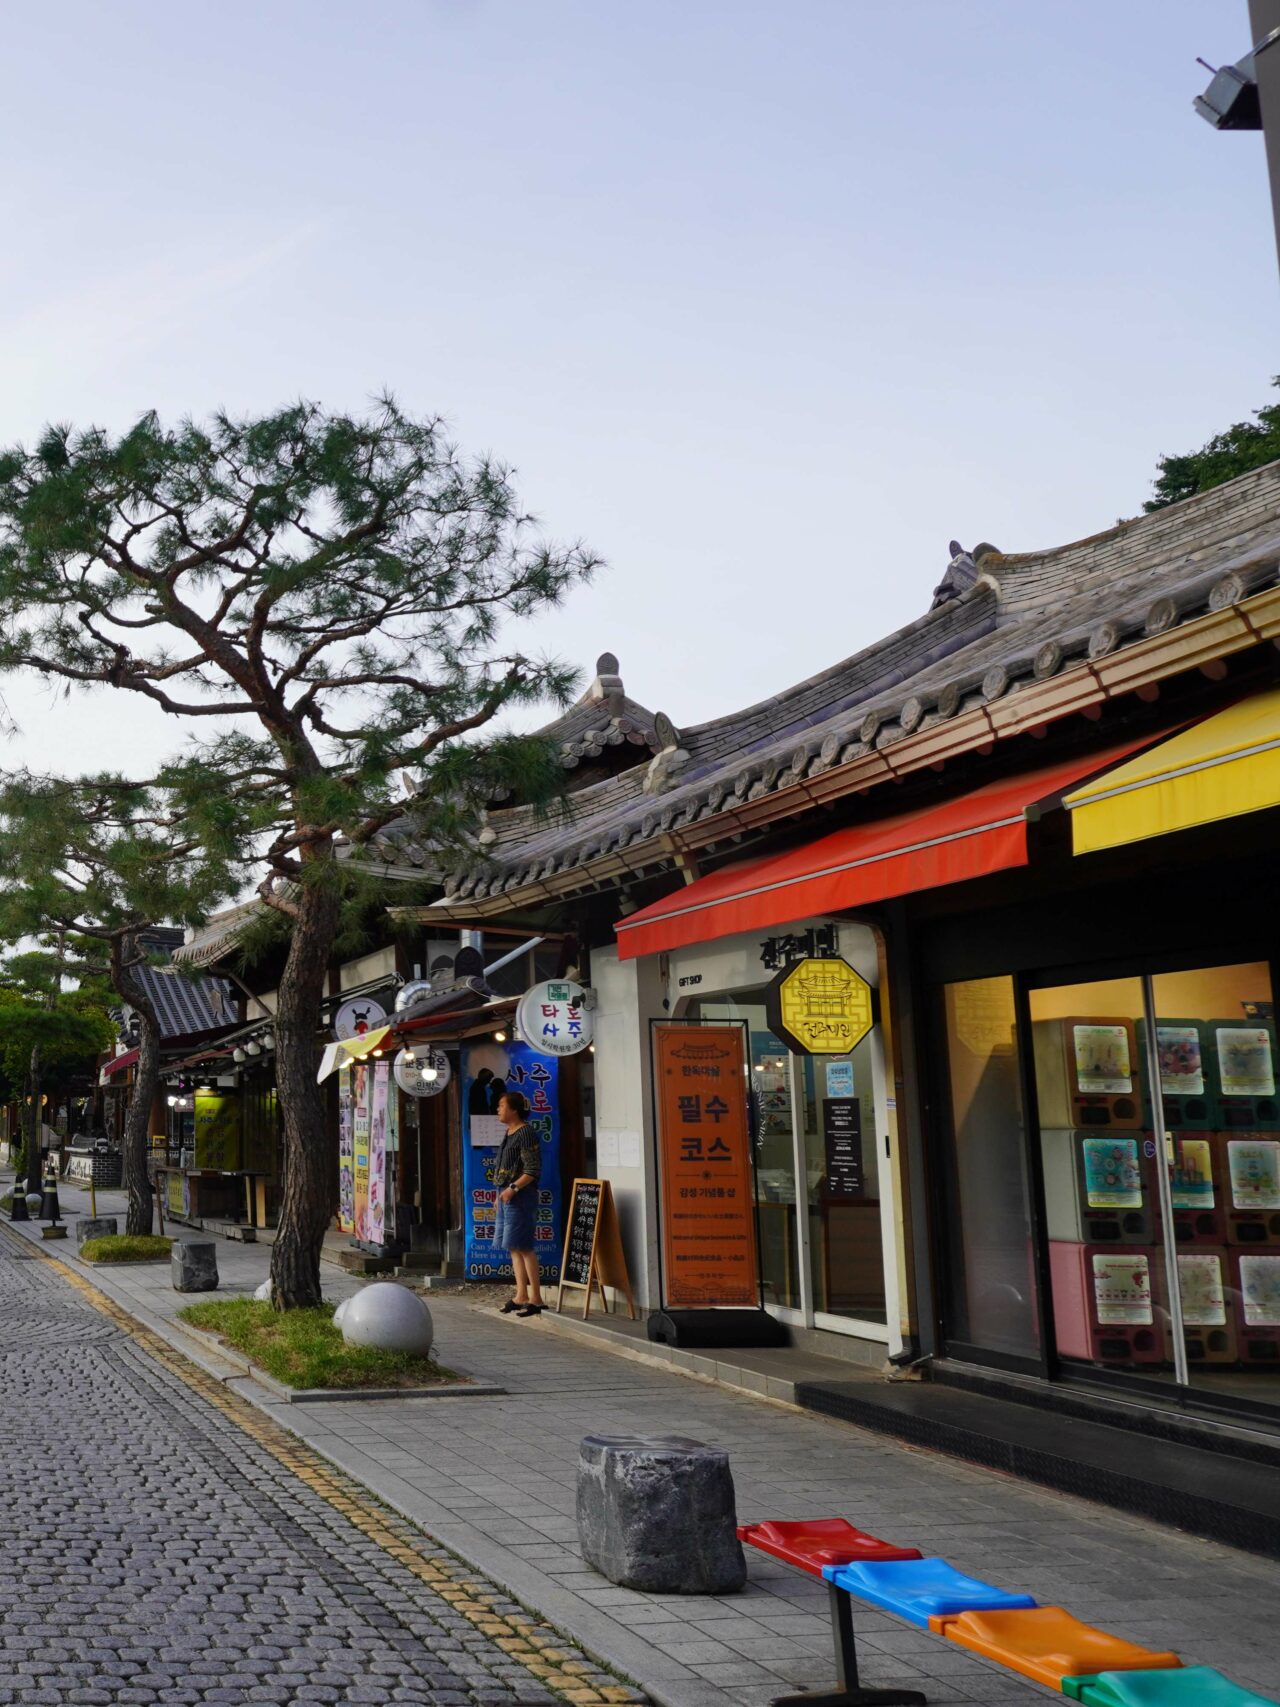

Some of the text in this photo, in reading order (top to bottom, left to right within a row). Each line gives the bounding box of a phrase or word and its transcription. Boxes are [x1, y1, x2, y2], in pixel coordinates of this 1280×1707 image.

[678, 974, 702, 987] GIFT SHOP
[543, 1021, 582, 1038] 사주
[803, 1021, 851, 1039] 전주미인
[506, 1063, 552, 1088] 사주
[678, 1094, 729, 1123] 필수
[680, 1137, 732, 1161] 코스
